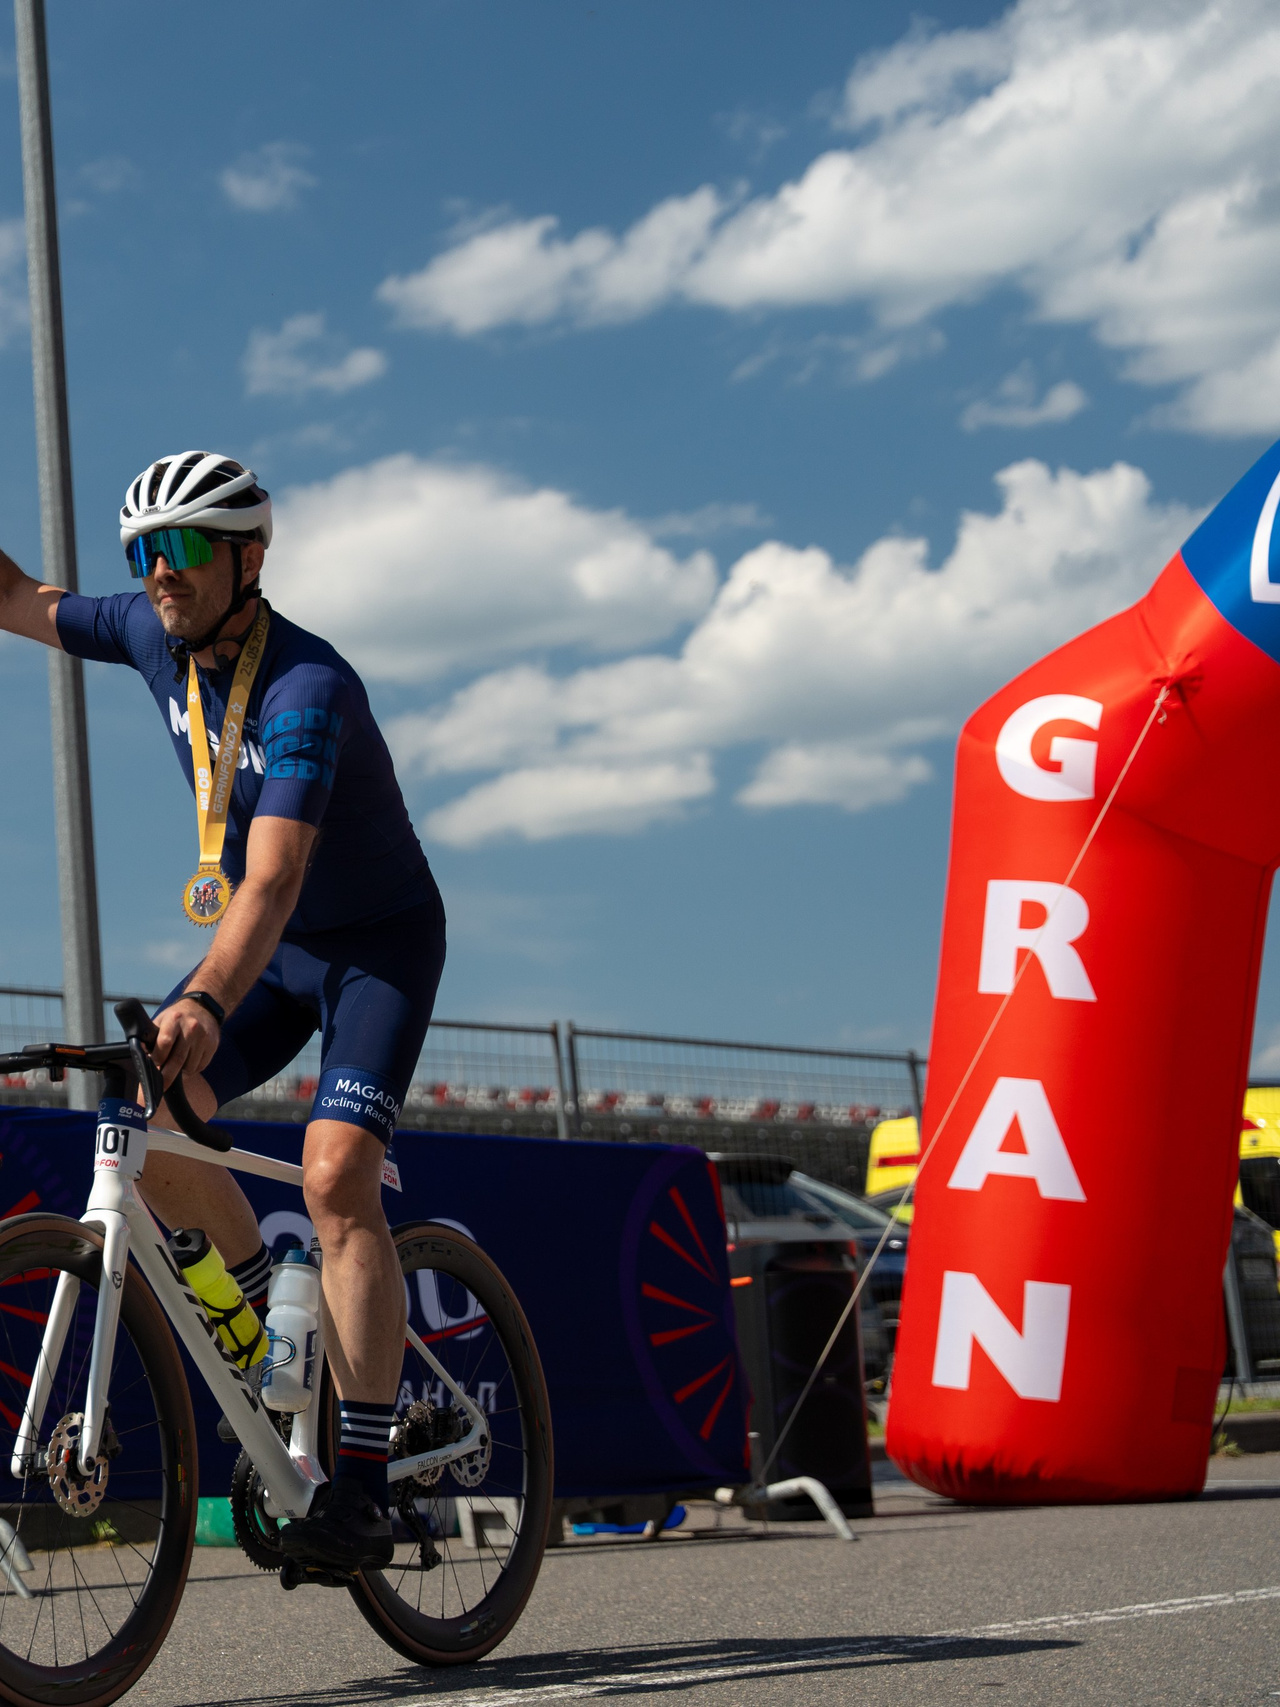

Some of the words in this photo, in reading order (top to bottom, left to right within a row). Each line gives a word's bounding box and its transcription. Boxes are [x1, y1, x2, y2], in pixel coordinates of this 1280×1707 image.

[239, 615, 269, 677] 25.05.2025
[197, 767, 210, 789] 60
[213, 721, 239, 814] GRANFONDO
[198, 791, 209, 810] KM
[931, 693, 1104, 1403] GRAN
[118, 1106, 133, 1115] 60
[321, 1096, 361, 1113] Cycling
[364, 1104, 388, 1125] Race
[417, 1455, 439, 1470] FALCON
